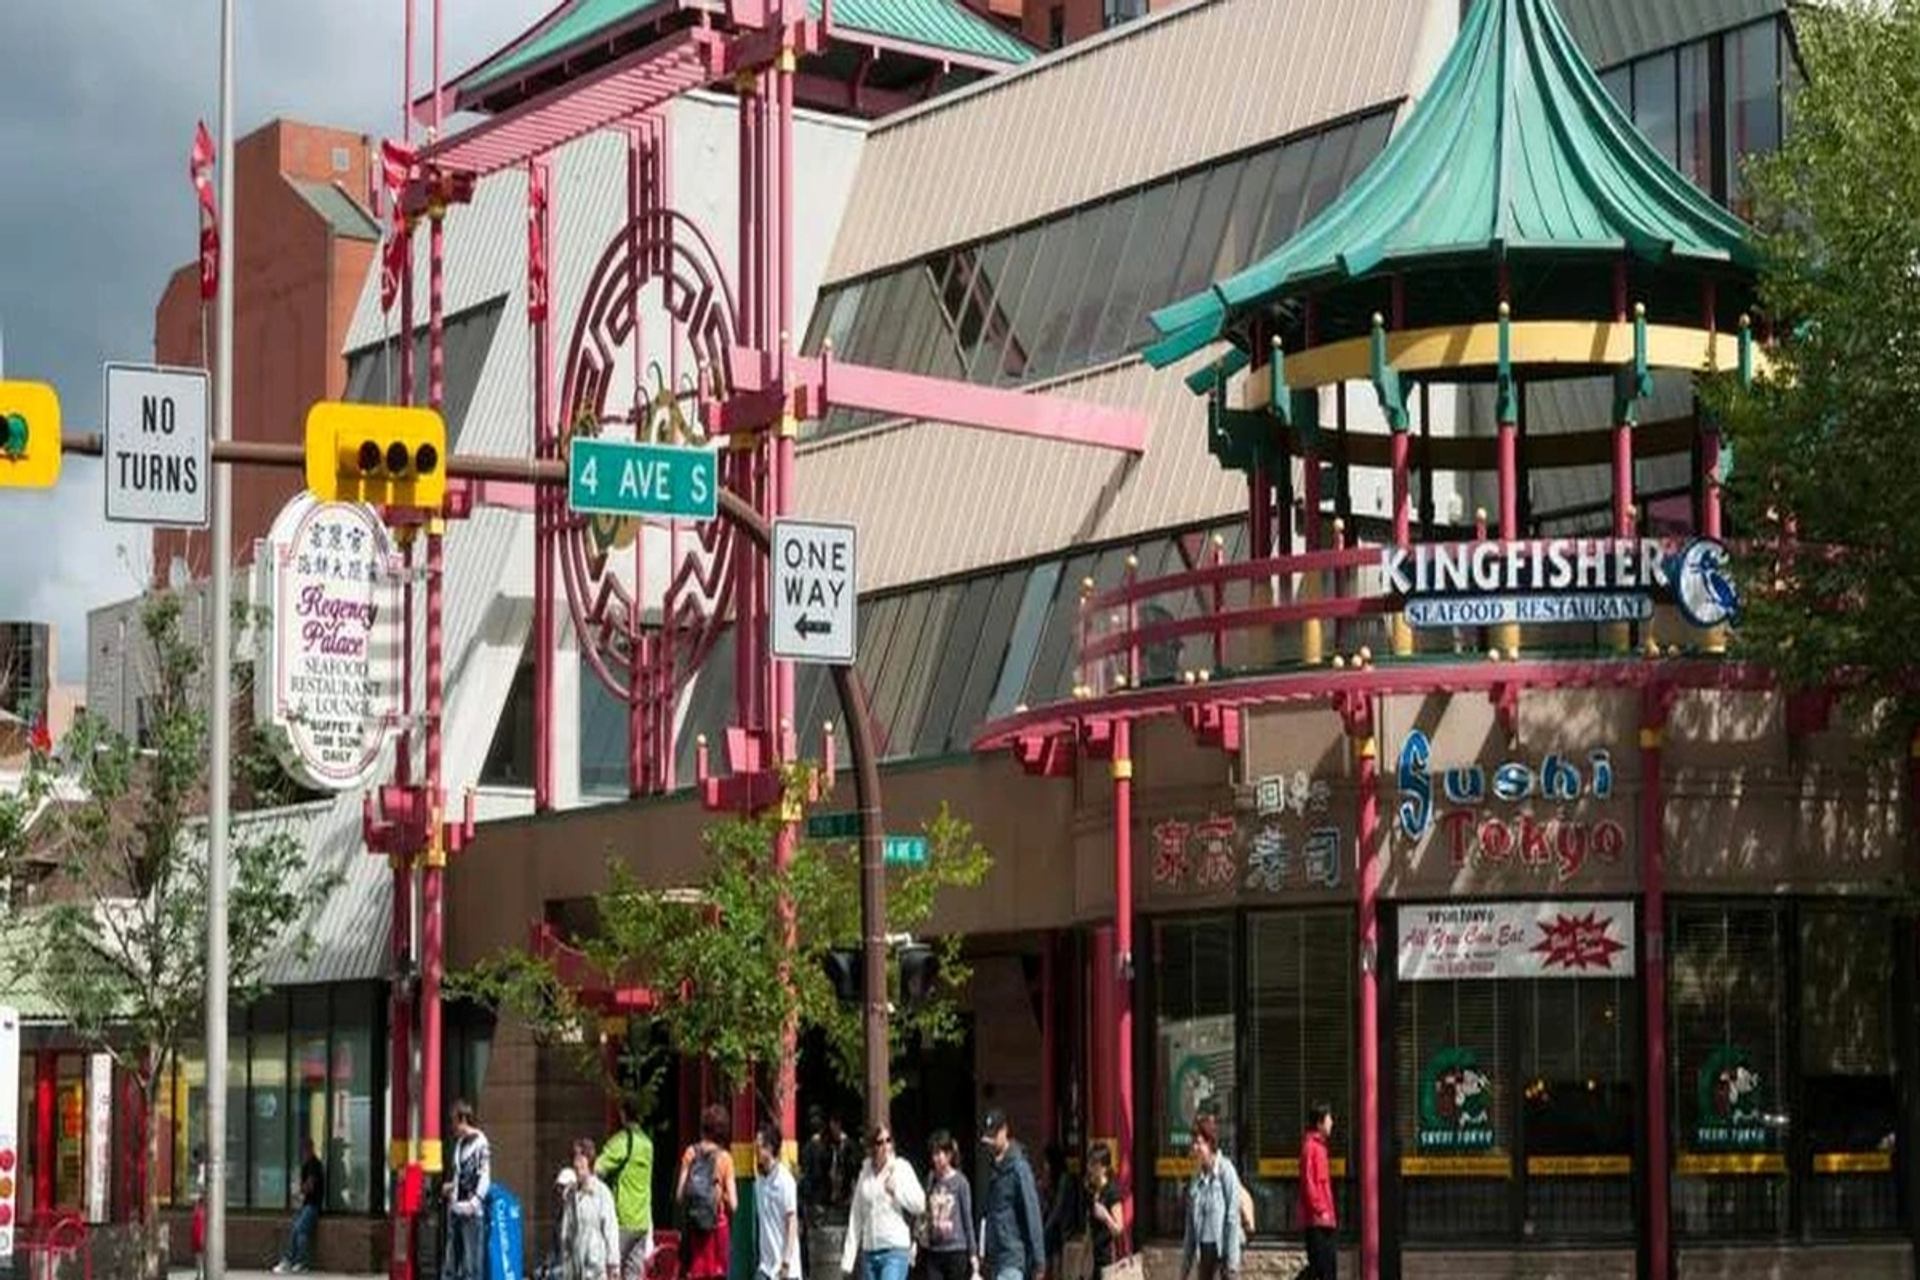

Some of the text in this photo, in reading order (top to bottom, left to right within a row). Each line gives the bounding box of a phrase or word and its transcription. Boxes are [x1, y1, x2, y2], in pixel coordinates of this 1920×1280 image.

[142, 395, 174, 434] NO
[117, 451, 197, 494] TURNS
[579, 455, 708, 504] 4 AVE S
[785, 538, 846, 571] ONE
[1380, 536, 1668, 595] KINGFISHER
[296, 584, 378, 632] Regency
[785, 576, 845, 609] WAY
[1409, 594, 1645, 625] SEAFOOD RESTAURANT
[302, 619, 364, 656] Palace
[305, 658, 369, 677] SEAFOOD
[291, 675, 382, 699] RESTAURANT
[1396, 729, 1613, 842] Sushi
[1442, 809, 1625, 883] Tokyo
[1497, 924, 1525, 947] Eat
